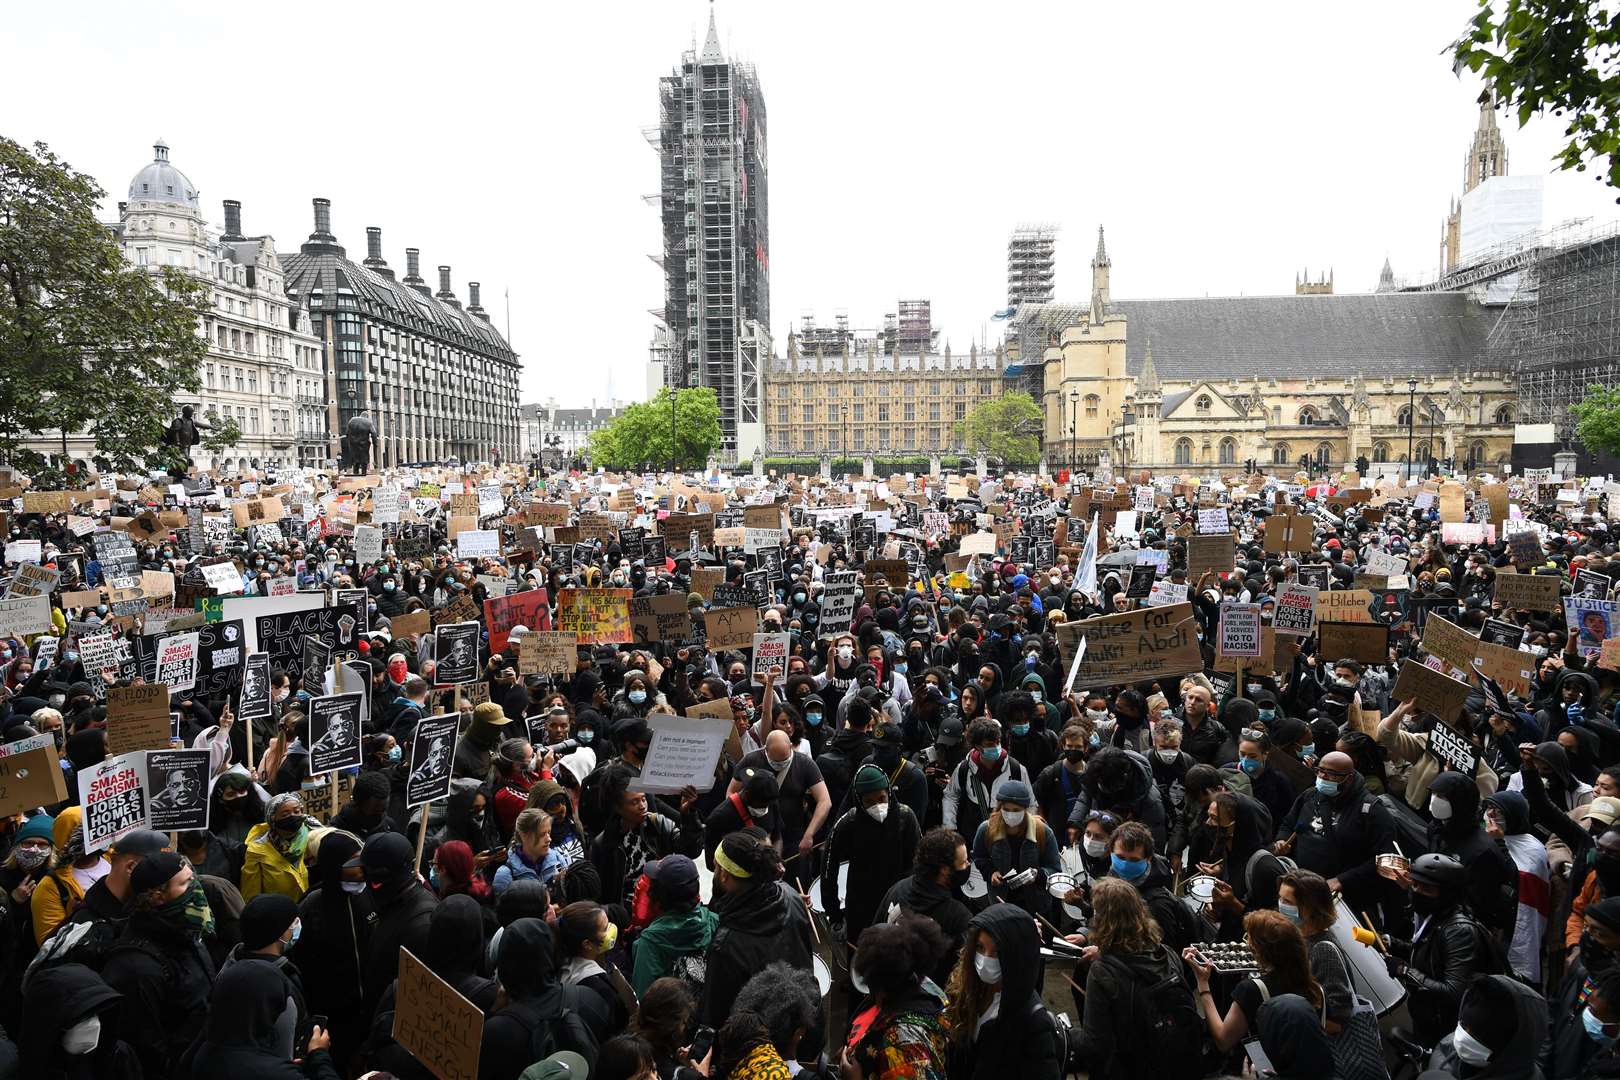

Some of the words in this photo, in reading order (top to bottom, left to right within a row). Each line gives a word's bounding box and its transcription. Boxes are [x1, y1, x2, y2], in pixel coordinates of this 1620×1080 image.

[1374, 556, 1396, 571] SAY
[826, 574, 856, 584] RESPECT
[714, 592, 738, 600] BLACK
[1282, 592, 1311, 602] SMASH
[833, 598, 844, 607] OR
[1279, 599, 1312, 609] RACISM!
[1566, 598, 1617, 612] JUSTICE
[823, 607, 852, 618] EXPECT
[1280, 607, 1302, 615] JOBS
[562, 615, 580, 623] STOP
[718, 611, 742, 625] AM
[1278, 612, 1309, 623] HOMES
[260, 610, 334, 638] BLACK
[728, 624, 733, 634] I
[1276, 620, 1292, 628] FOR
[712, 632, 752, 648] NEXT?
[1138, 628, 1188, 654] Abdi
[164, 644, 192, 655] SMASH
[757, 648, 785, 657] RACISM!
[760, 642, 784, 651] SMASH
[161, 652, 193, 664] RACISM!
[757, 657, 776, 665] JOBS
[162, 662, 183, 672] JOBS
[184, 658, 192, 667] &
[537, 664, 568, 674] LOVE?
[87, 668, 101, 677] END
[161, 667, 191, 680] HOMES
[177, 675, 191, 685] ALL
[464, 684, 486, 696] THIS
[1435, 722, 1472, 753] BLACK
[1432, 731, 1469, 764] LIVES
[1432, 744, 1469, 774] MATTER
[90, 768, 136, 792] SMASH
[87, 778, 140, 804] RACISM!
[91, 792, 128, 817] JOBS
[128, 789, 140, 801] &
[91, 800, 141, 828] HOMES
[89, 824, 119, 842] FOR
[120, 813, 145, 832] ALL
[403, 983, 418, 1008] IS
[405, 958, 473, 1030] RACISM
[424, 1000, 470, 1048] SMALL
[416, 1013, 458, 1056] DICK
